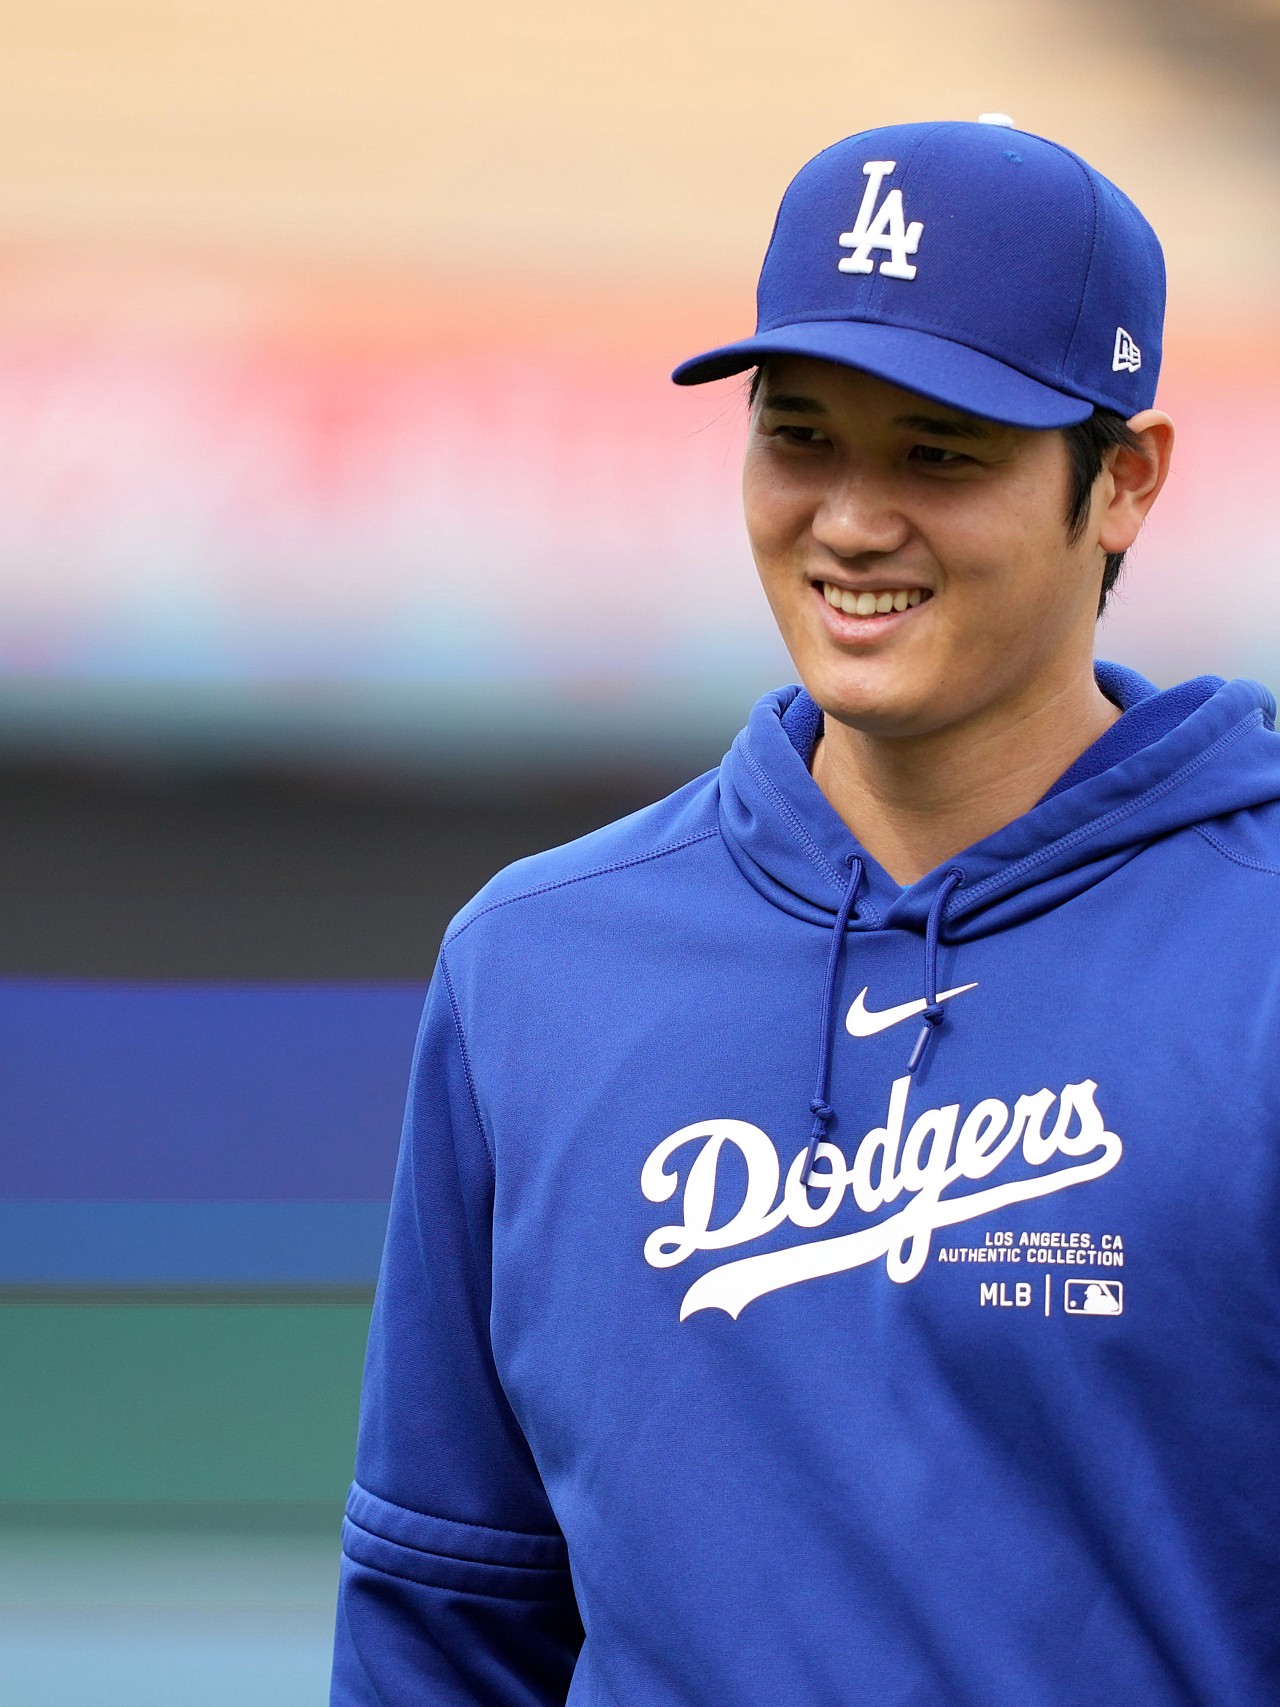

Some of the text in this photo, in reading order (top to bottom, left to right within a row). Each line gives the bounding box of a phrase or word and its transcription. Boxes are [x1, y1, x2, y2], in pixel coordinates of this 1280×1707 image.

[838, 160, 925, 281] LA
[641, 1075, 1124, 1286] Dodgers
[984, 1231, 1124, 1251] LOS ANGELES, CA
[938, 1247, 1124, 1267] AUTHENTIC COLLECTION
[980, 1282, 1032, 1307] MLB
